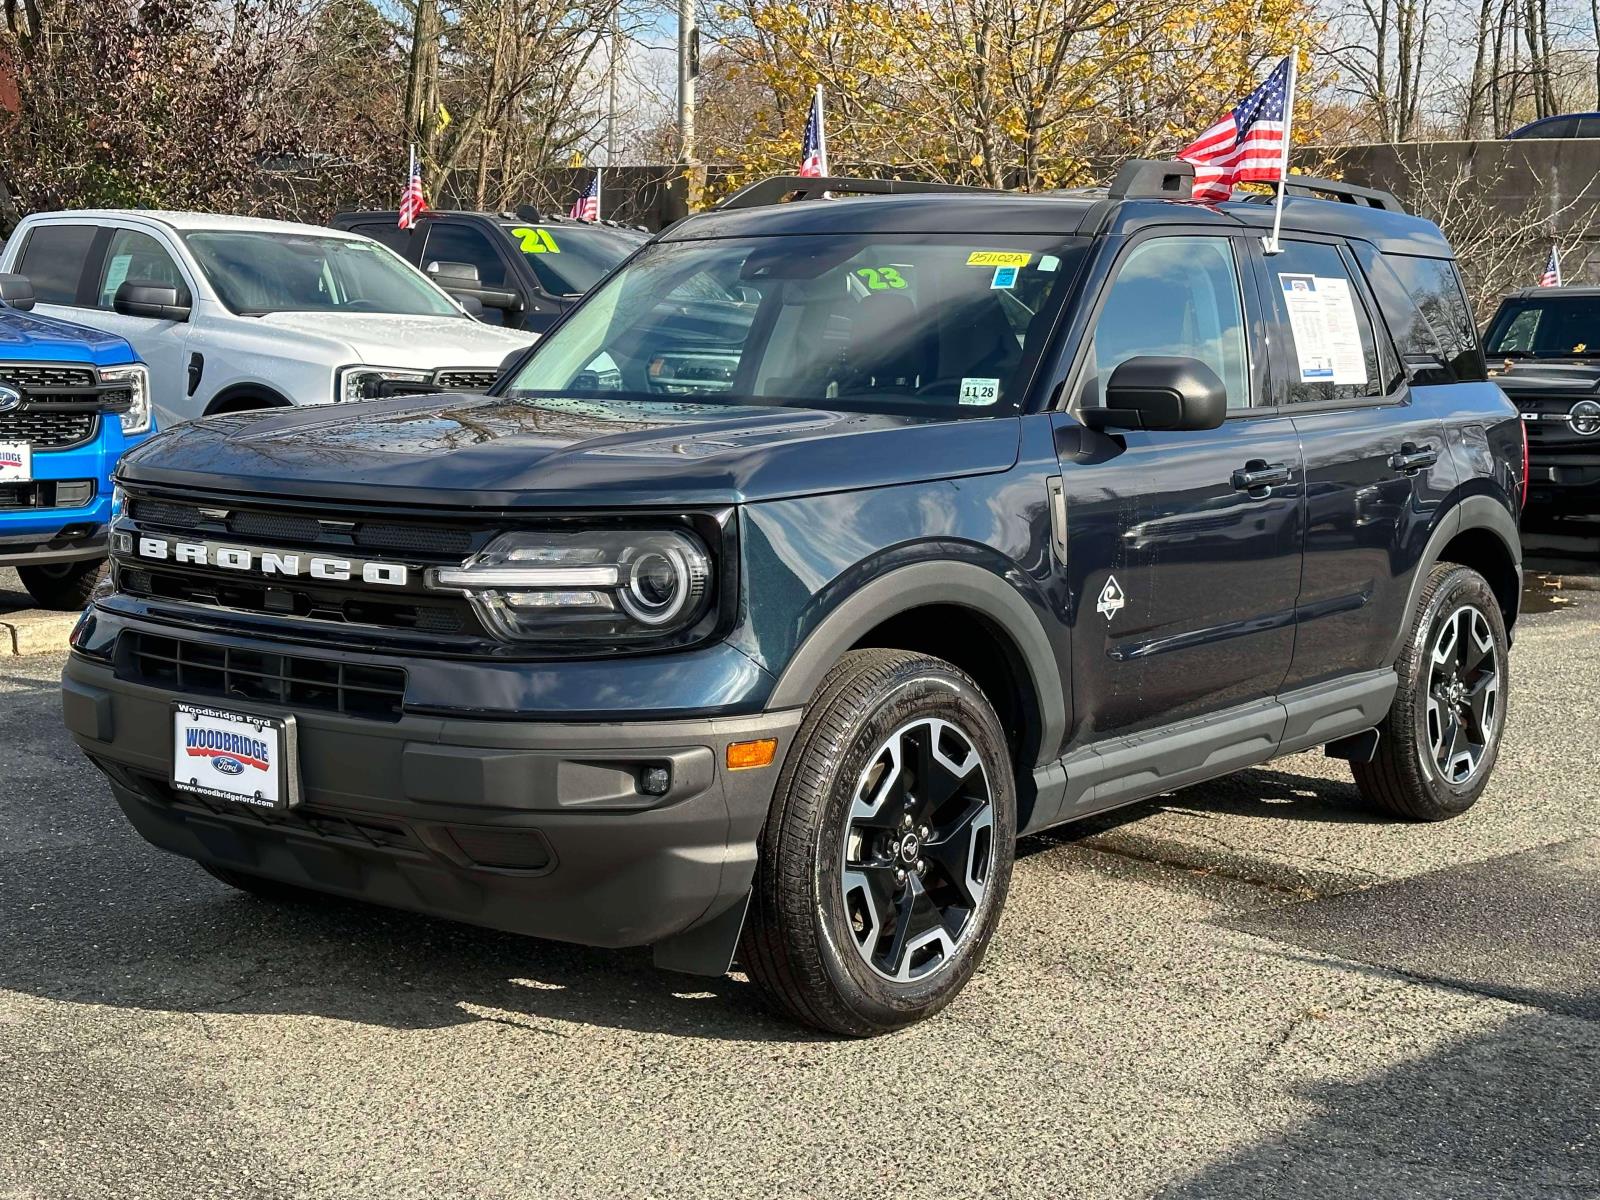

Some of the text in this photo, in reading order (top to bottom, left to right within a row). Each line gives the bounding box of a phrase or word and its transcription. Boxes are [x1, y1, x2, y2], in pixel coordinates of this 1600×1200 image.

[511, 228, 560, 253] 21
[857, 267, 906, 289] 23
[964, 386, 994, 398] 11 28
[139, 537, 408, 586] BRONCO
[178, 704, 271, 727] Woodbridge Ford
[185, 727, 269, 763] WOODBRIDGE
[217, 757, 239, 773] Ford
[176, 783, 274, 808] www.woodbridgeford.com
